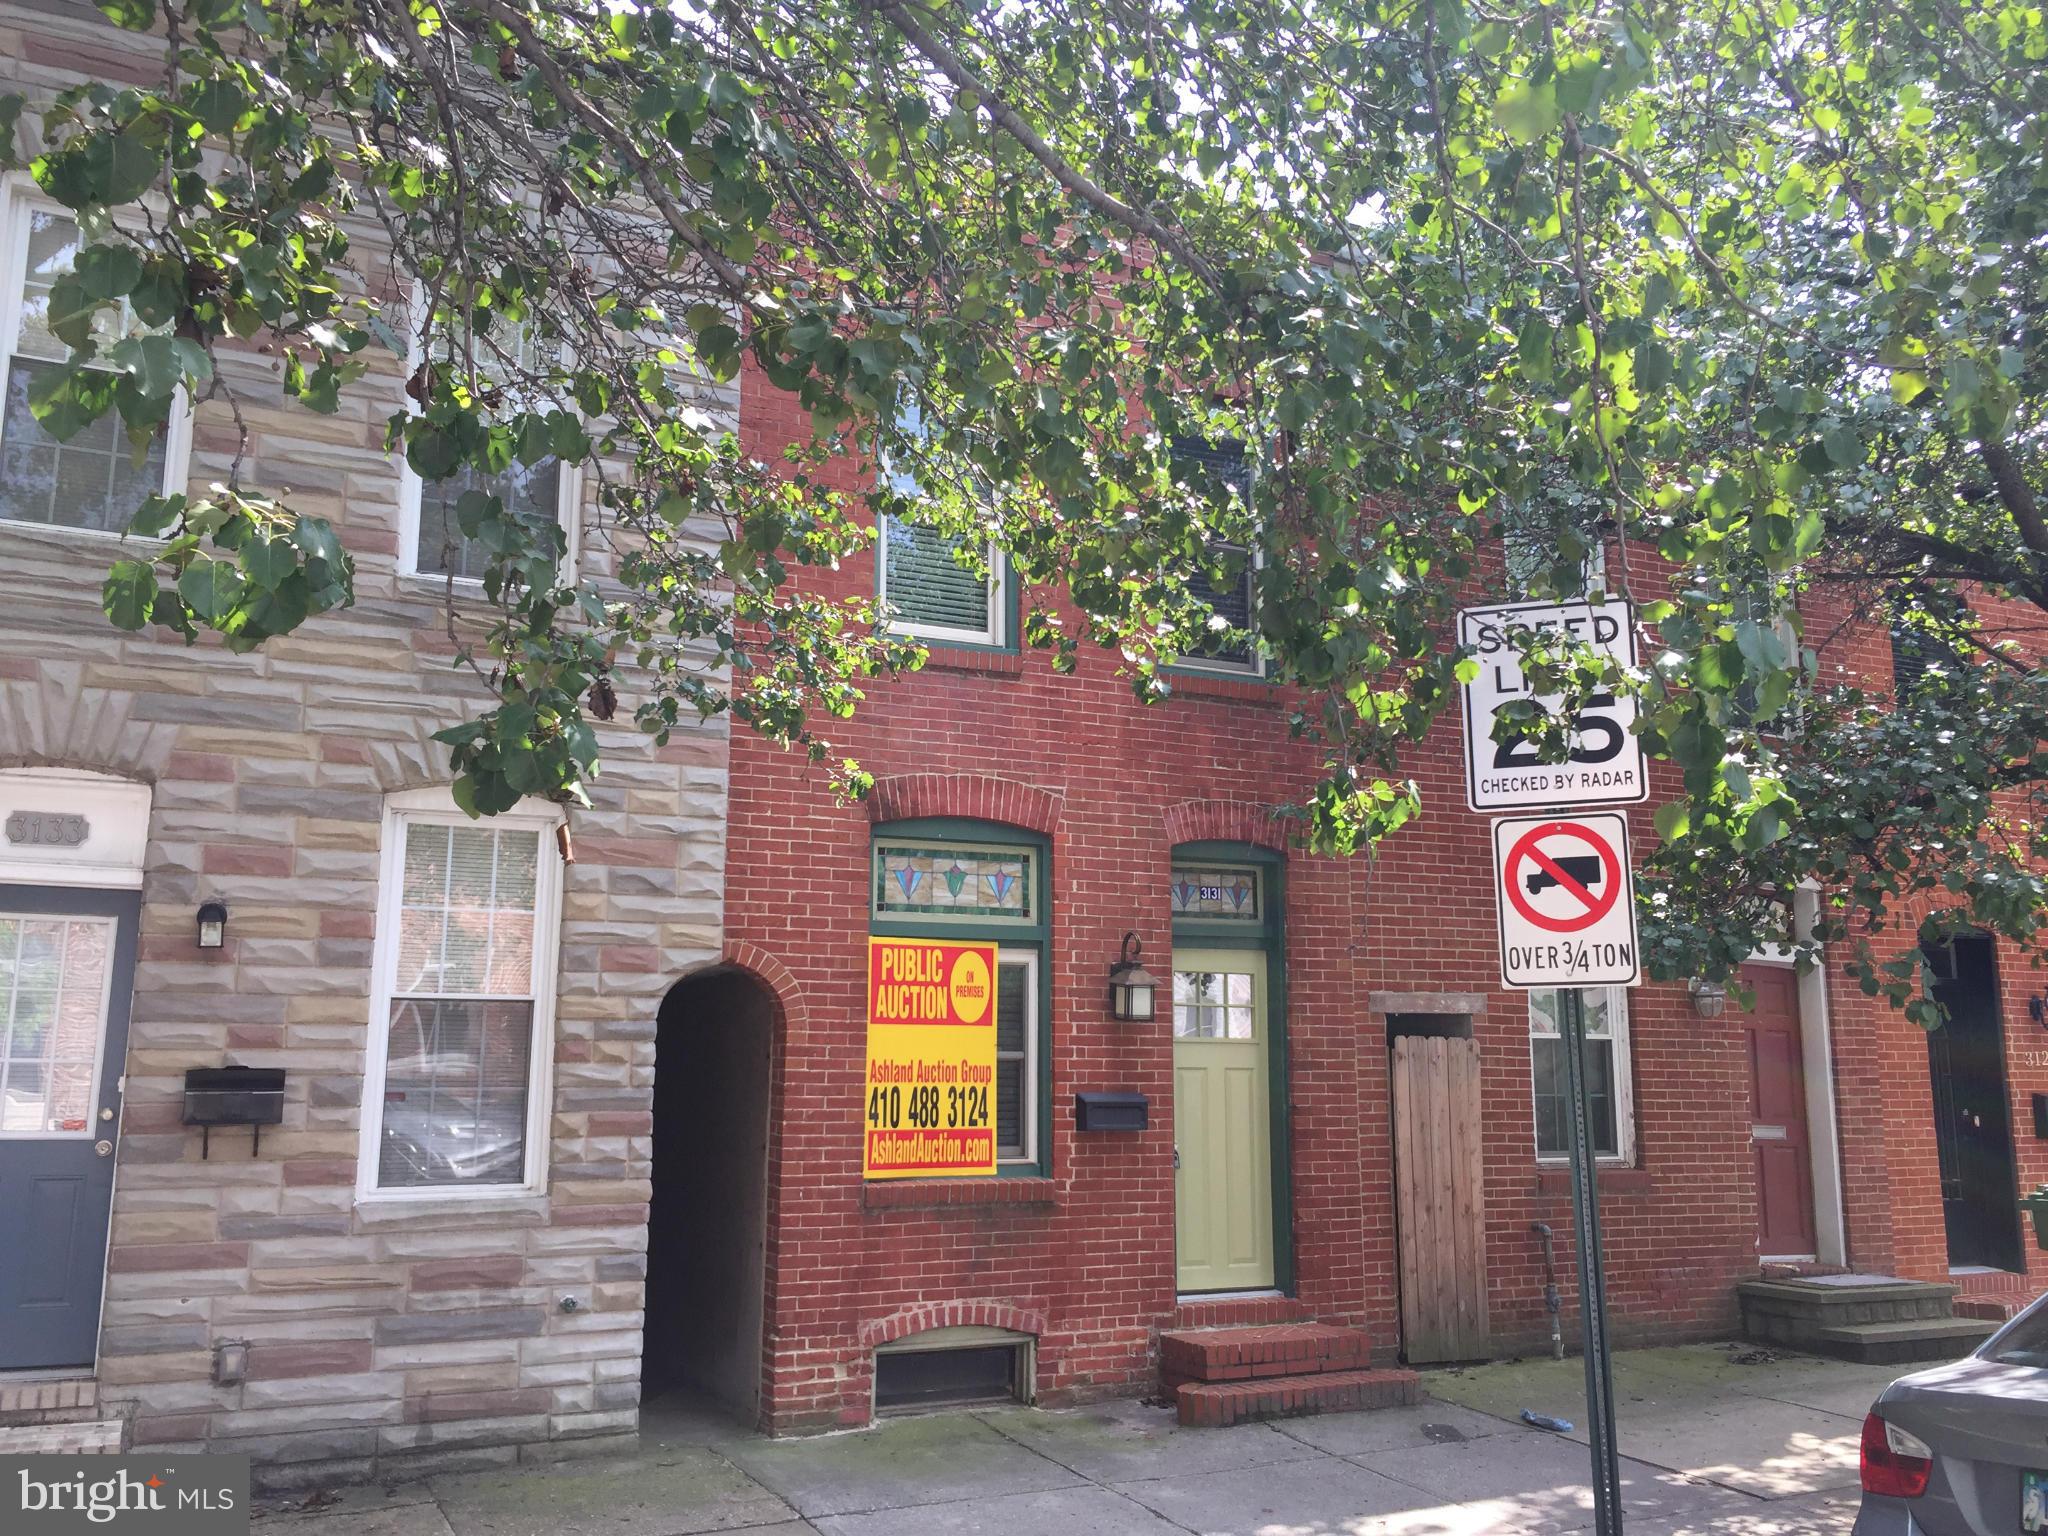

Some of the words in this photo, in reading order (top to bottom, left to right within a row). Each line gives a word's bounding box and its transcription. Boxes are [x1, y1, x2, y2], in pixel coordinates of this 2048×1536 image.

[1477, 615, 1619, 654] SPED
[1490, 693, 1625, 769] 25
[1481, 776, 1549, 794] CHECKED
[1555, 774, 1575, 789] BY
[1581, 770, 1634, 788] RADAR
[9, 817, 83, 843] 3133
[881, 947, 943, 983] PUBLIC
[966, 970, 974, 984] ON
[1509, 946, 1559, 970] OVER
[1592, 943, 1631, 967] TON
[875, 984, 948, 1020] AUCTION
[955, 985, 984, 999] PREMISES
[869, 1059, 914, 1083] Ashland
[916, 1060, 958, 1083] Auction
[961, 1060, 992, 1086] Group
[868, 1086, 900, 1128] 410
[908, 1086, 940, 1128] 488
[947, 1086, 988, 1127] 3124
[871, 1131, 990, 1165] AshlandAuction.com
